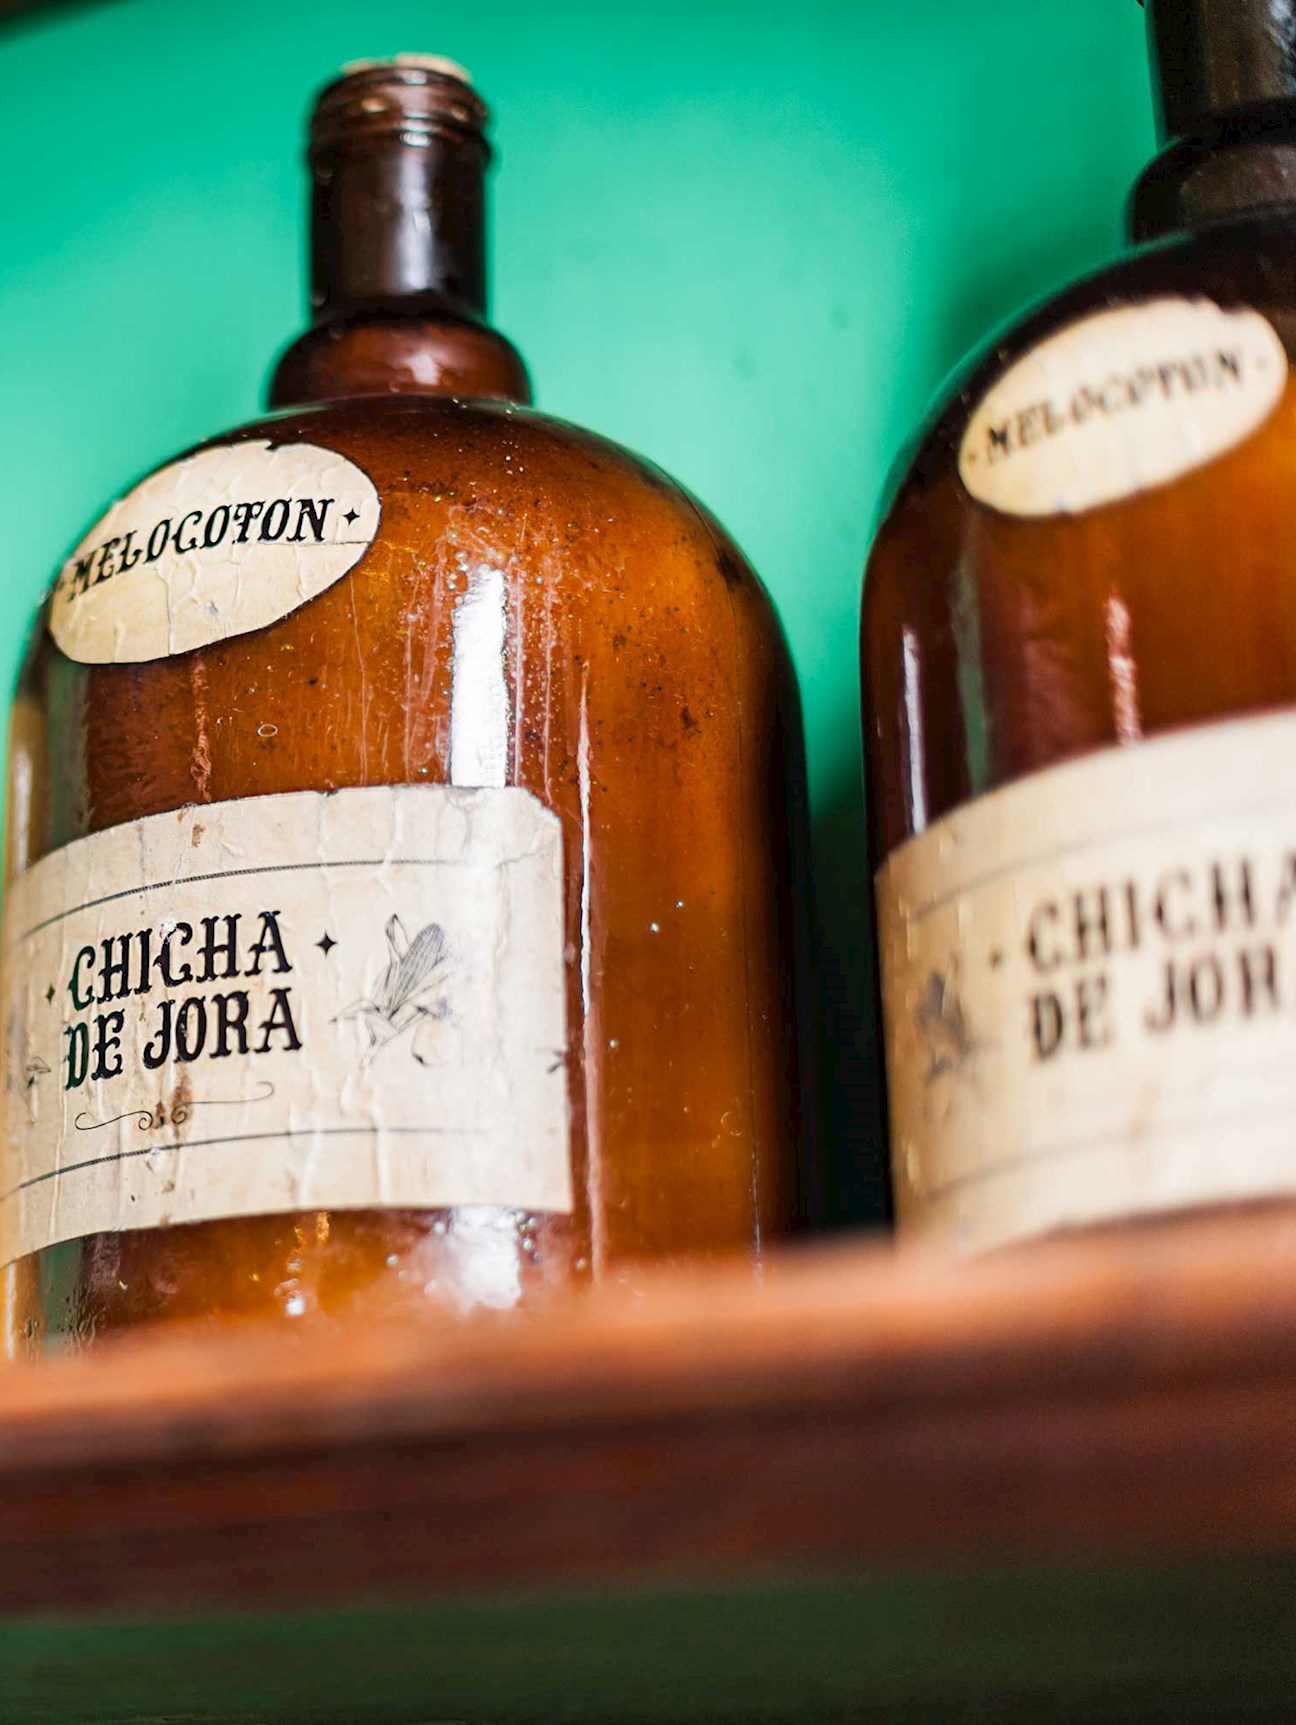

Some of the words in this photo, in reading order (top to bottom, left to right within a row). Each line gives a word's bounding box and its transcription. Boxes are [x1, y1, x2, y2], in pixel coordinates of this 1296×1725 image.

[68, 498, 334, 603] MELOCOTON
[67, 910, 293, 1012] CHICHA
[64, 1009, 126, 1090] DE
[142, 987, 303, 1070] JORA
[1030, 974, 1111, 1062] DE
